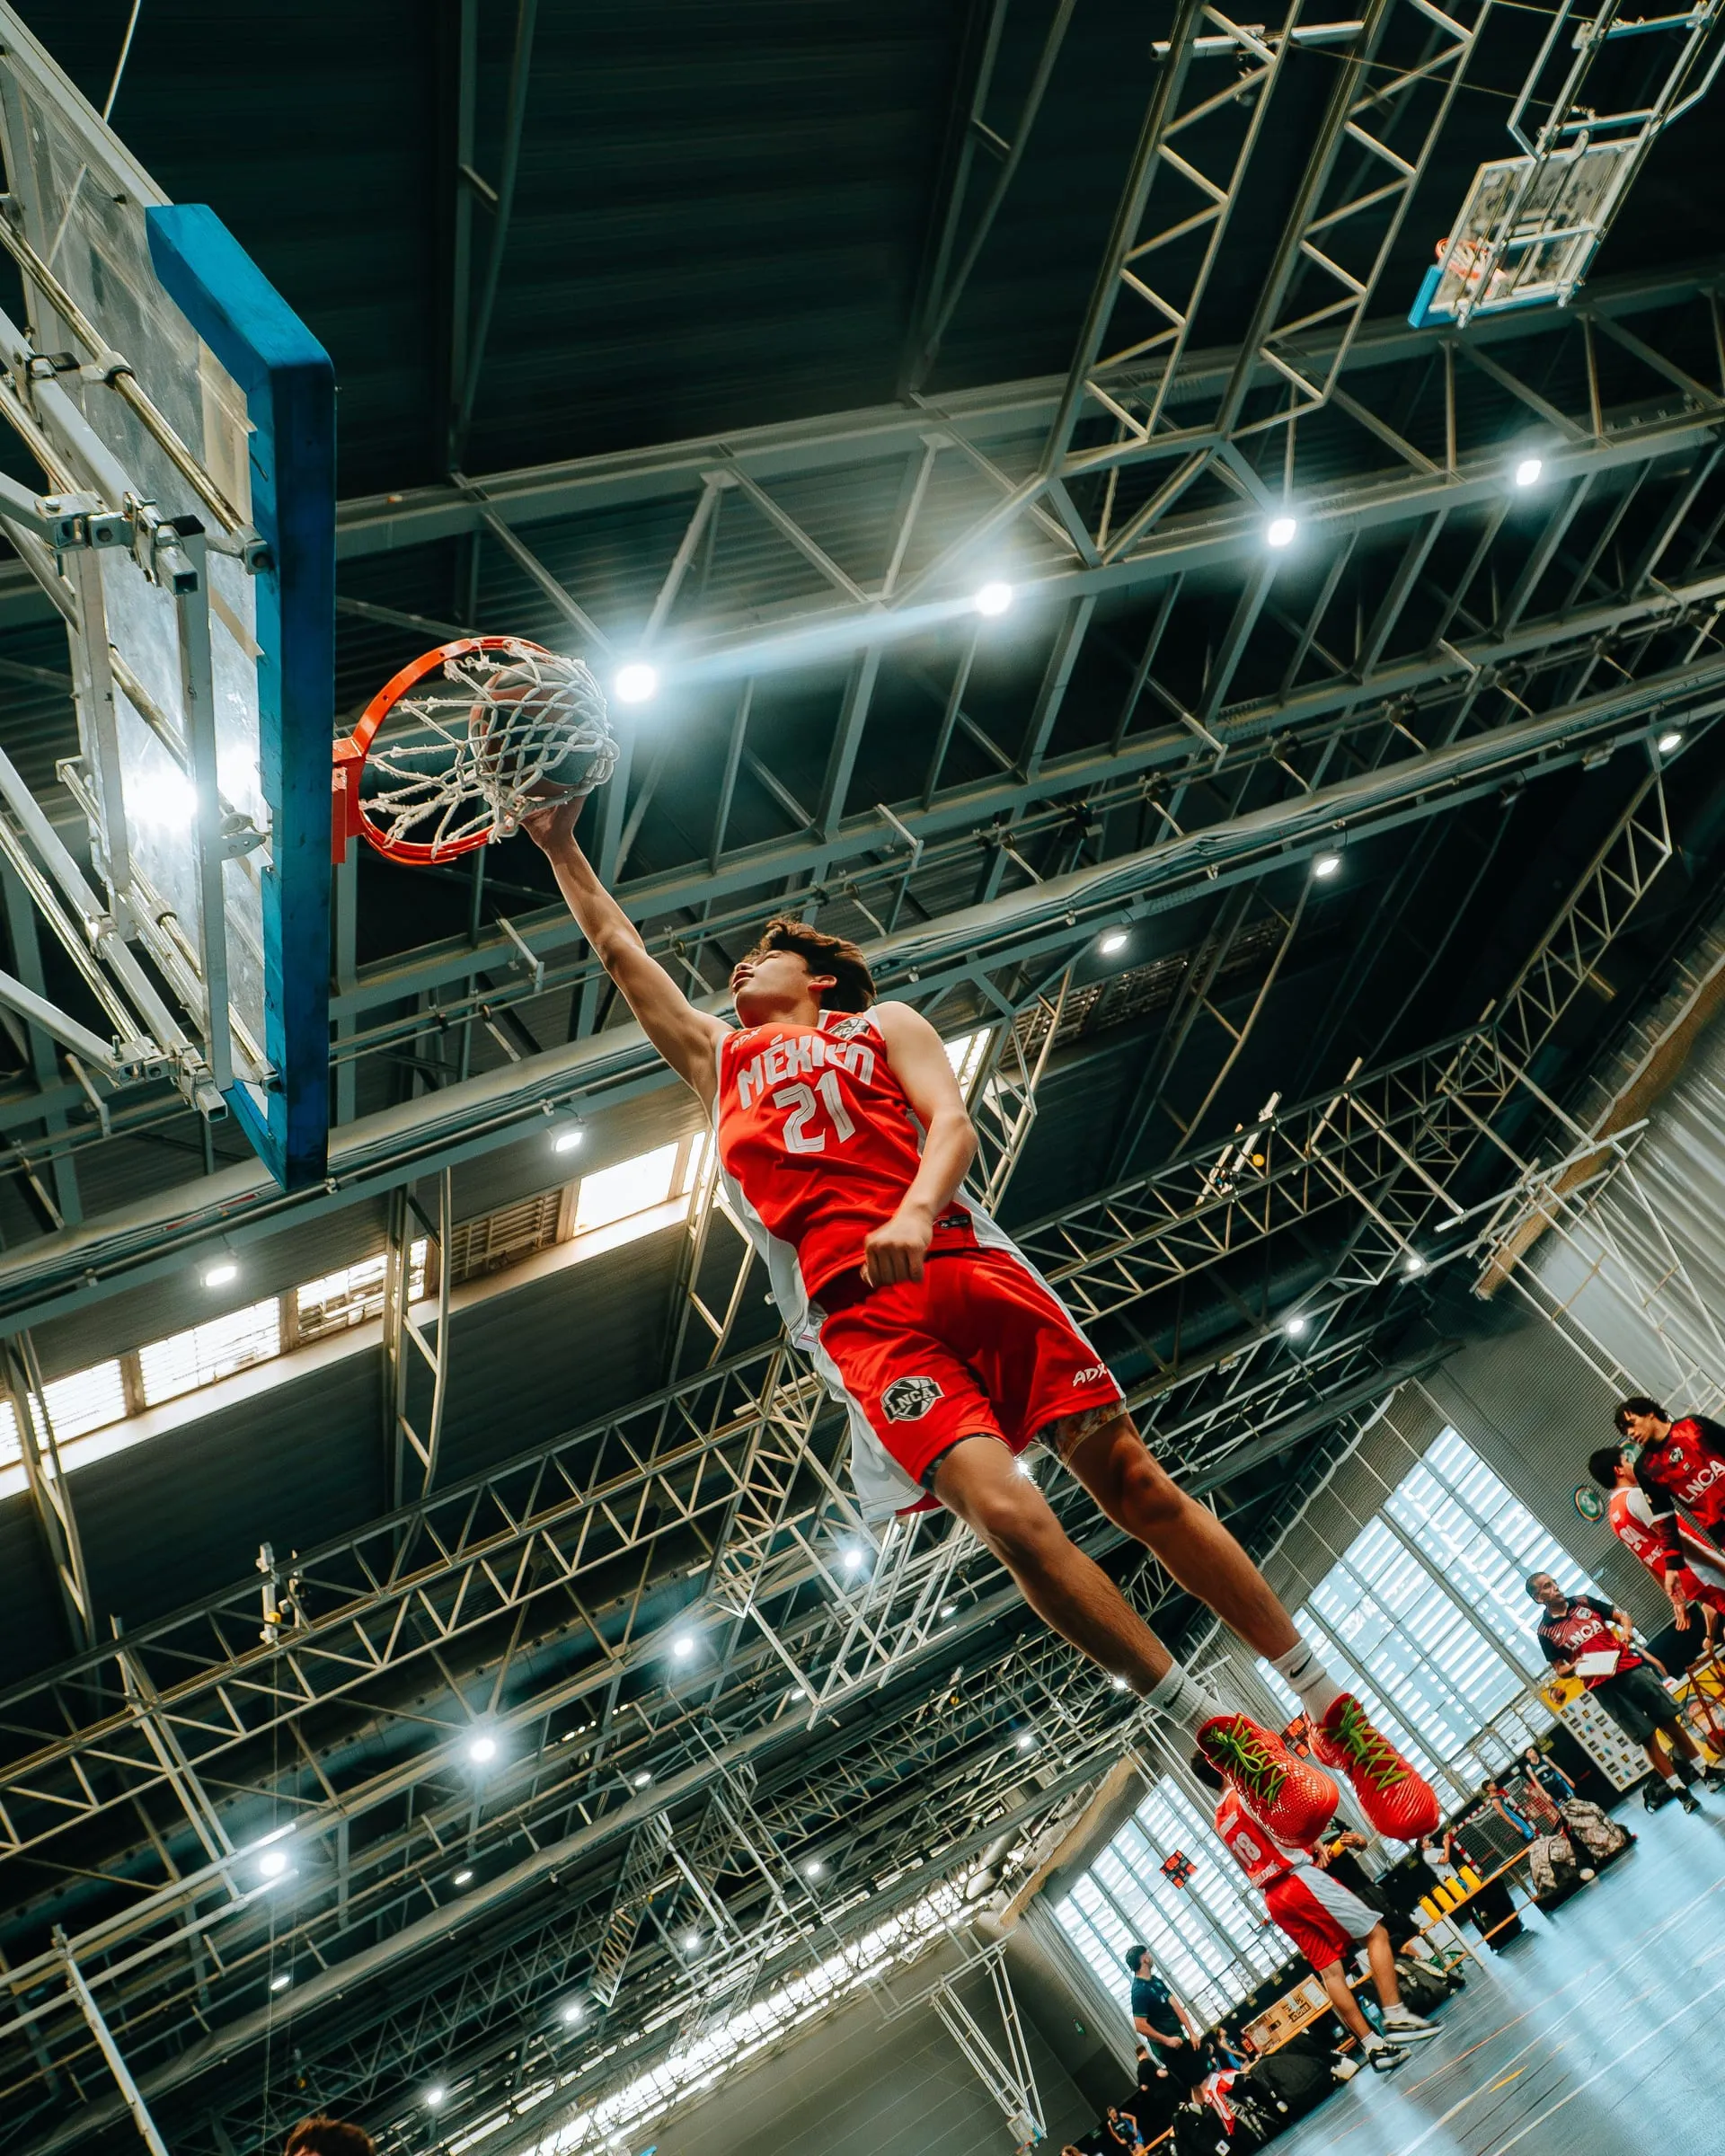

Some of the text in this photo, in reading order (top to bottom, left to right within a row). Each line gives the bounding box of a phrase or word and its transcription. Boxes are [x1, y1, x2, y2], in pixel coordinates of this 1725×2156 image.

[772, 1069, 856, 1153] 21
[1073, 1363, 1108, 1387] ADX
[889, 1388, 936, 1416] LNCA
[1678, 1460, 1725, 1503] LNCA
[1564, 1620, 1605, 1652] LNCA
[1232, 1832, 1261, 1869] 18
